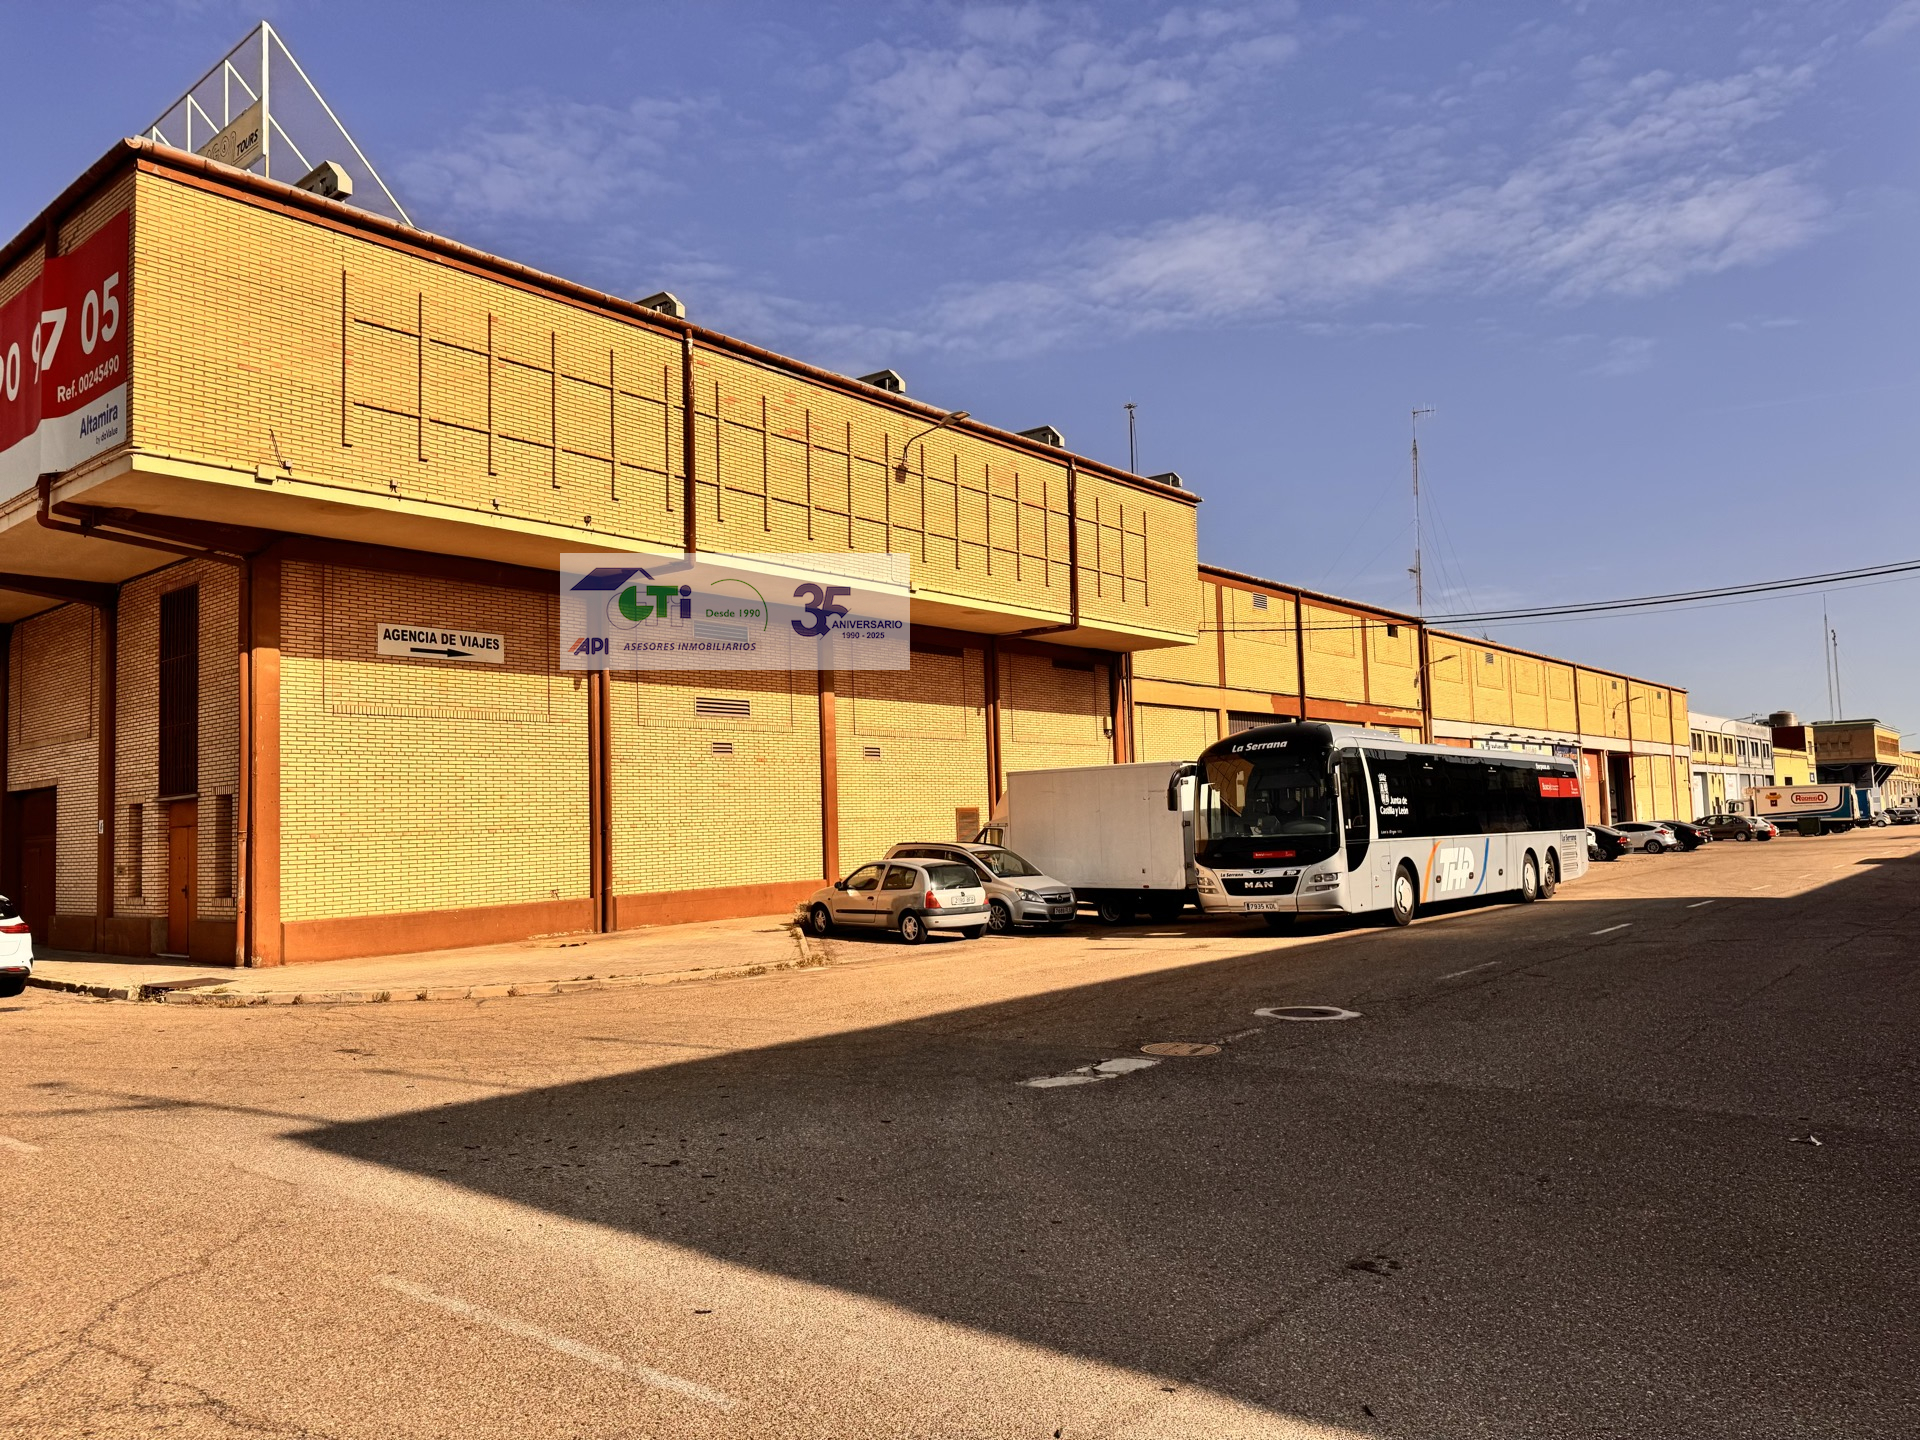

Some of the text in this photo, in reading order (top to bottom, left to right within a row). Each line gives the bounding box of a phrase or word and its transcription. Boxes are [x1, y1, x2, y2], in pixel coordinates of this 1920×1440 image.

[237, 128, 259, 156] TOURS
[31, 307, 68, 385] 97
[81, 271, 120, 355] 05
[57, 354, 120, 403] Ref. 00245490
[79, 403, 118, 439] Altamira
[383, 628, 500, 650] AGENCIA DE VIAJES
[1232, 740, 1288, 753] La Serrana
[1380, 806, 1395, 815] Castilla
[1244, 881, 1274, 889] MAN
